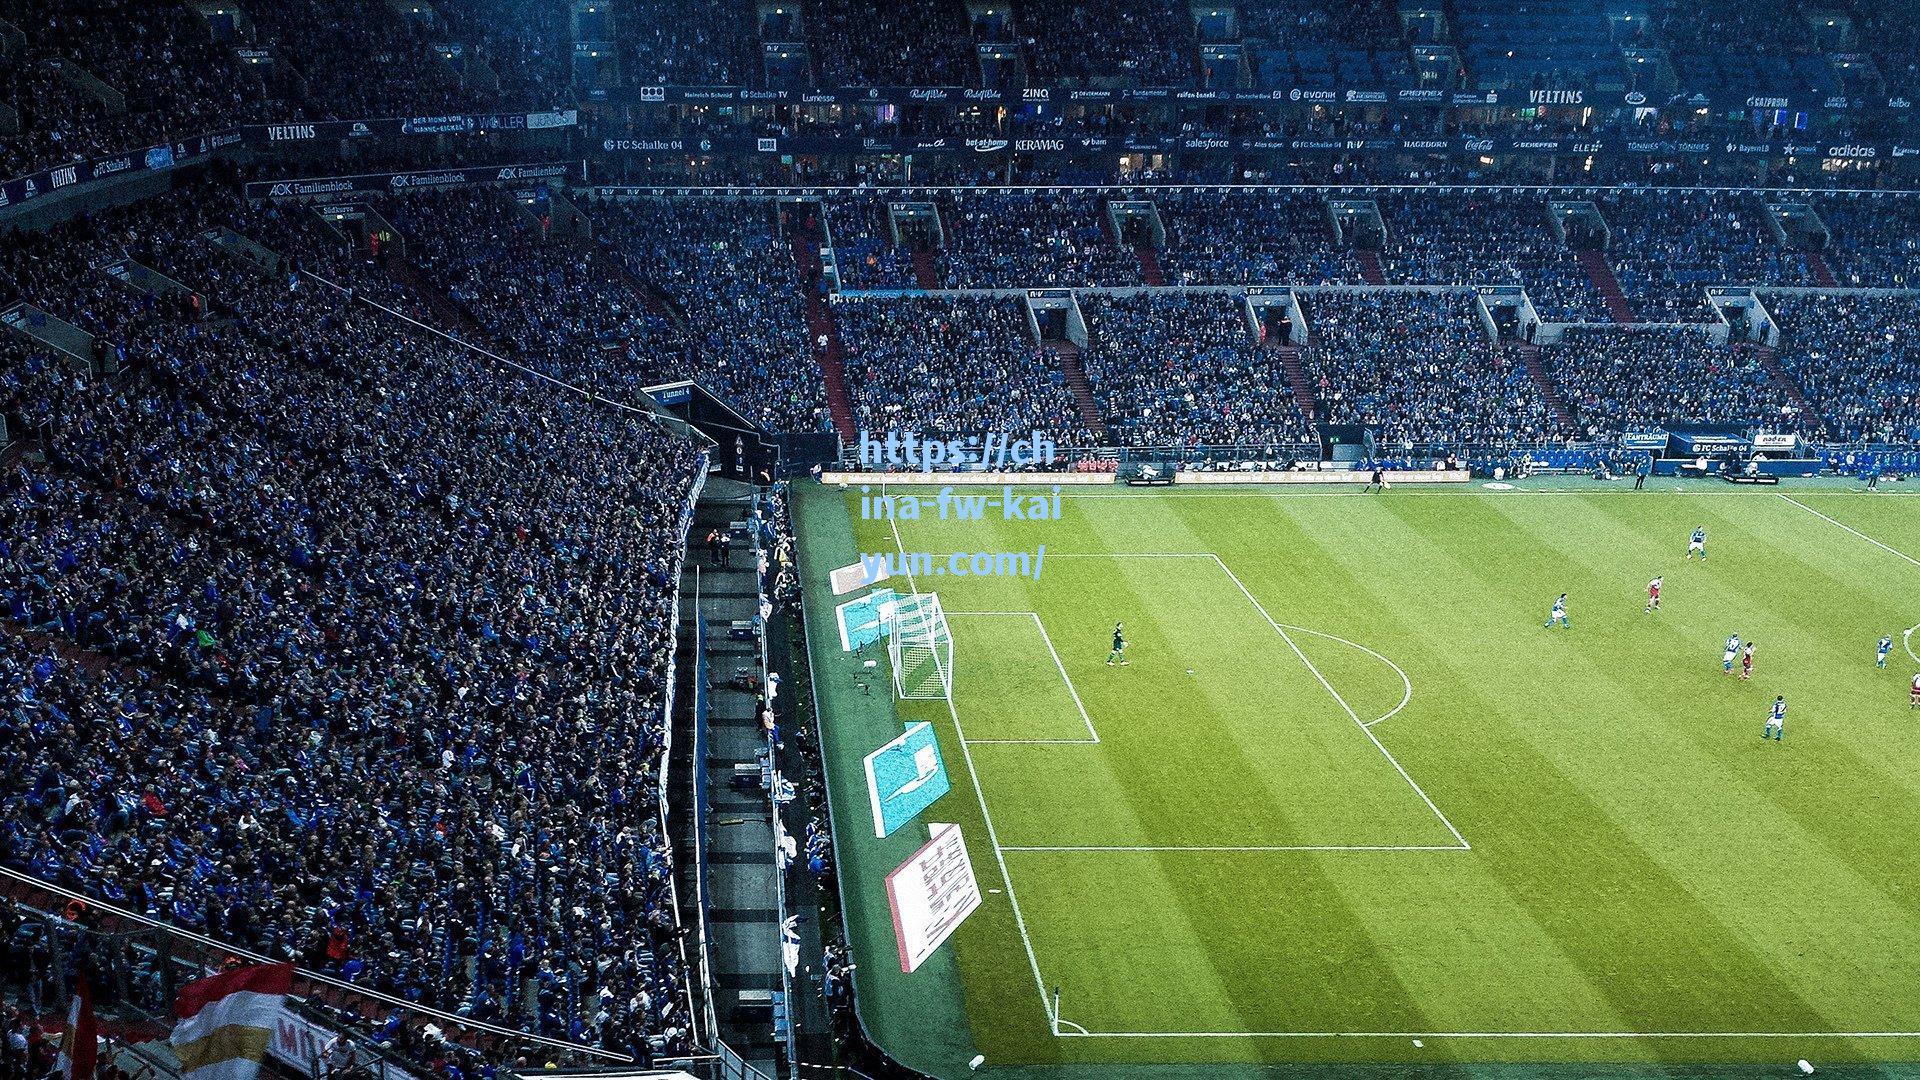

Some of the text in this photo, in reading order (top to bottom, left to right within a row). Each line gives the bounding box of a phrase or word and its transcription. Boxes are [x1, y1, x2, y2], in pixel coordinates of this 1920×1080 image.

[1022, 89, 1048, 98] ZINQ
[1529, 90, 1582, 104] VELTINS
[268, 125, 316, 140] VELTINS
[617, 140, 682, 149] FC Schalke 04
[1015, 140, 1064, 150] KERAMAG
[1186, 138, 1229, 150] salesforce
[1573, 144, 1589, 152] ELE
[1829, 145, 1875, 157] adidas
[51, 166, 76, 188] VELTINS
[390, 172, 465, 187] AOK Familienblock
[497, 168, 517, 180] AOK
[269, 181, 353, 196] AOK Familienblock
[662, 389, 685, 398] Tunnel
